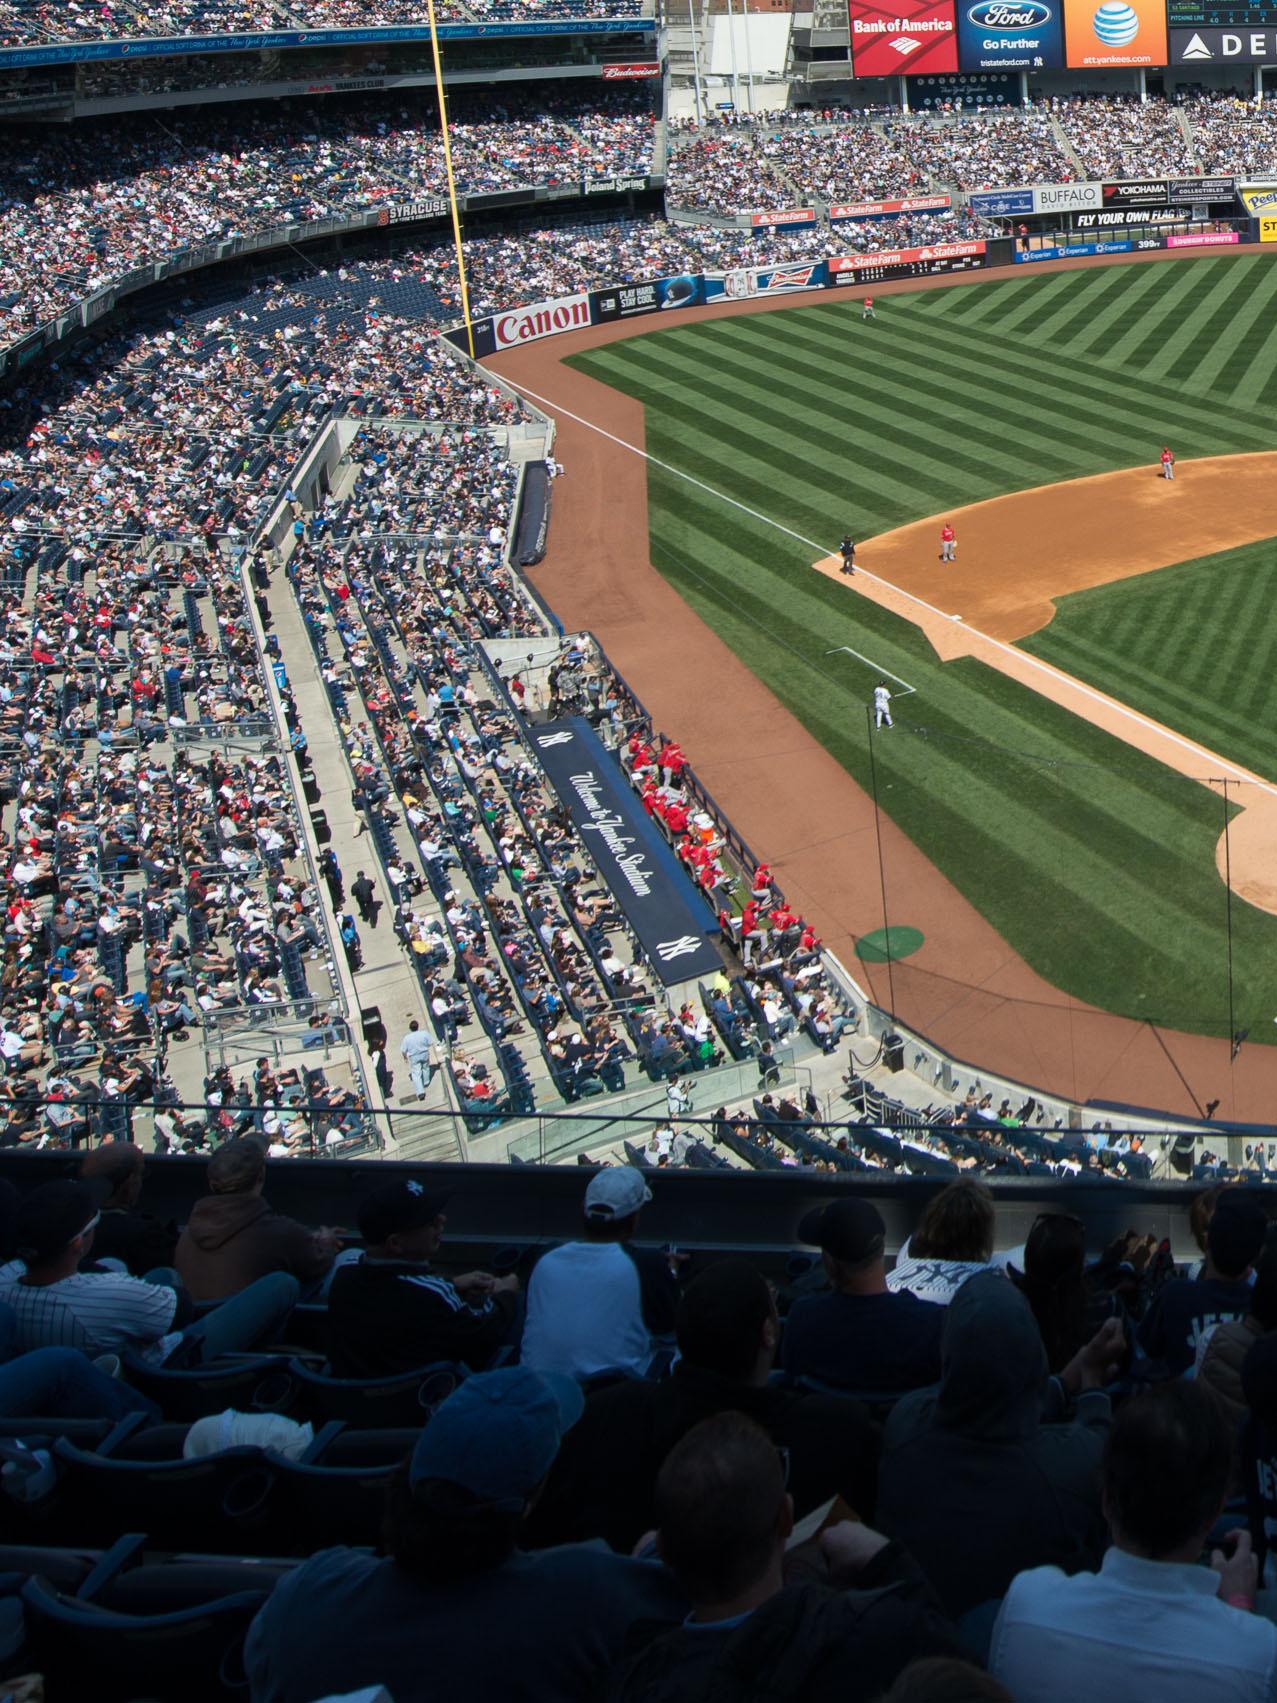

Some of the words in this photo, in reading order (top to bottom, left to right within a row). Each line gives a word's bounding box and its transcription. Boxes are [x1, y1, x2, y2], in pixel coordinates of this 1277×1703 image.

[984, 4, 1034, 25] Ford
[854, 20, 886, 33] Bank
[887, 18, 900, 32] of
[901, 17, 953, 32] America
[983, 40, 999, 49] Go
[1000, 38, 1040, 49] Further
[980, 59, 1030, 67] tristateford.com
[1083, 55, 1151, 65] att.yankees.com
[604, 66, 658, 77] Budweiser
[584, 180, 614, 195] Poland
[615, 179, 645, 192] Spring
[1118, 185, 1166, 195] YOKOHAMA
[1041, 188, 1095, 204] BUFFALO
[390, 201, 447, 218] SYRACUSE
[1078, 215, 1095, 226] FLY
[1098, 211, 1124, 224] YOUR
[1126, 210, 1149, 222] OWN
[1152, 208, 1175, 220] FLAG
[1066, 247, 1088, 255] Experian
[619, 288, 634, 299] PLAY
[635, 285, 655, 296] HARD.
[620, 298, 636, 308] STAY
[637, 294, 655, 305] COOL.
[496, 301, 589, 344] Canon
[569, 772, 602, 816] Welcome
[592, 809, 612, 821] to
[581, 815, 635, 857] Yankee
[616, 853, 653, 896] Stadium
